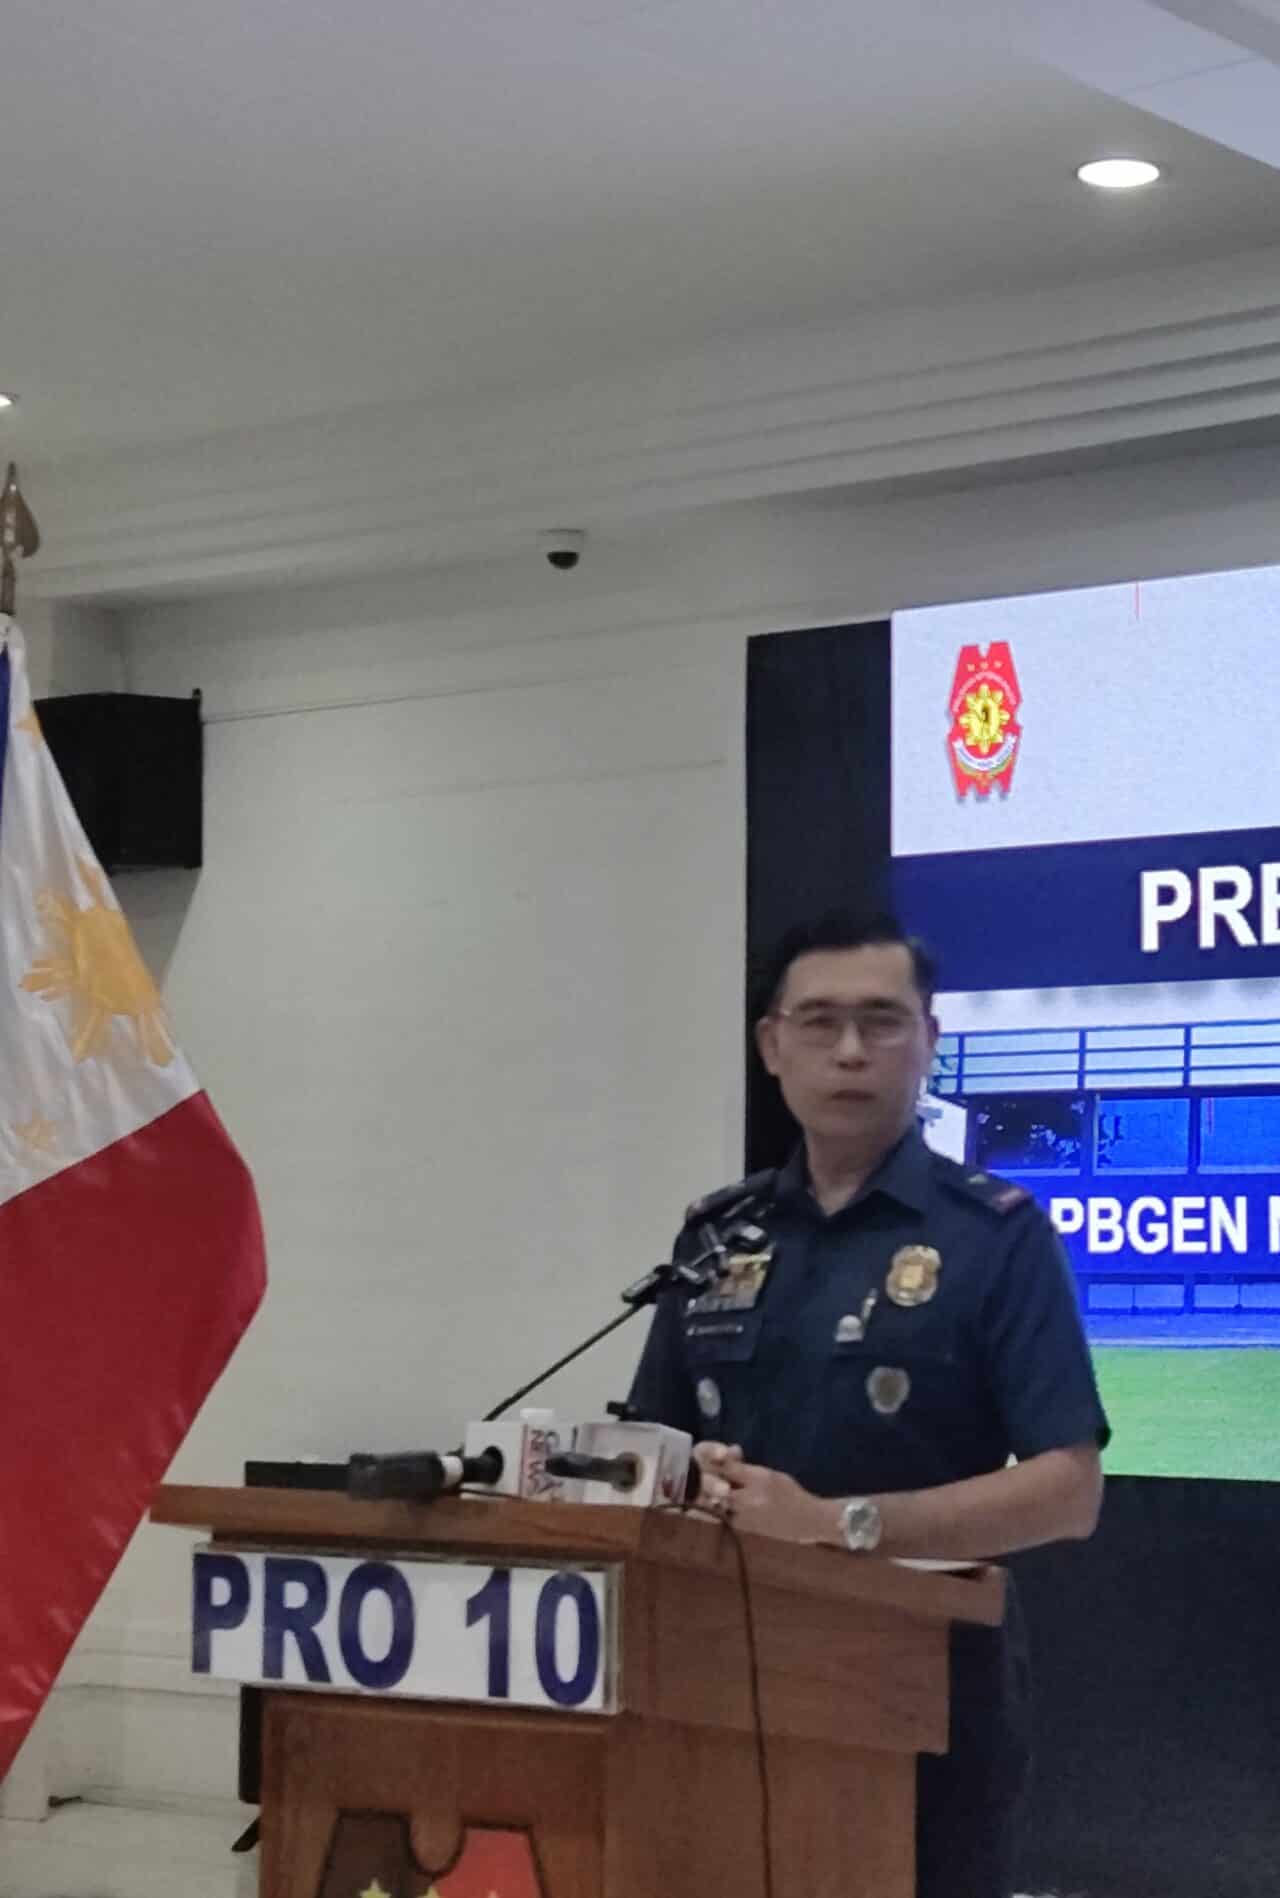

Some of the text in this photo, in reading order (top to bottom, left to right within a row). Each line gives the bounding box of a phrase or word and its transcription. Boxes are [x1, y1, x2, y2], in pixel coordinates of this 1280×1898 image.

[1050, 1196, 1247, 1254] PBGEN
[192, 1553, 600, 1707] PRO 10
